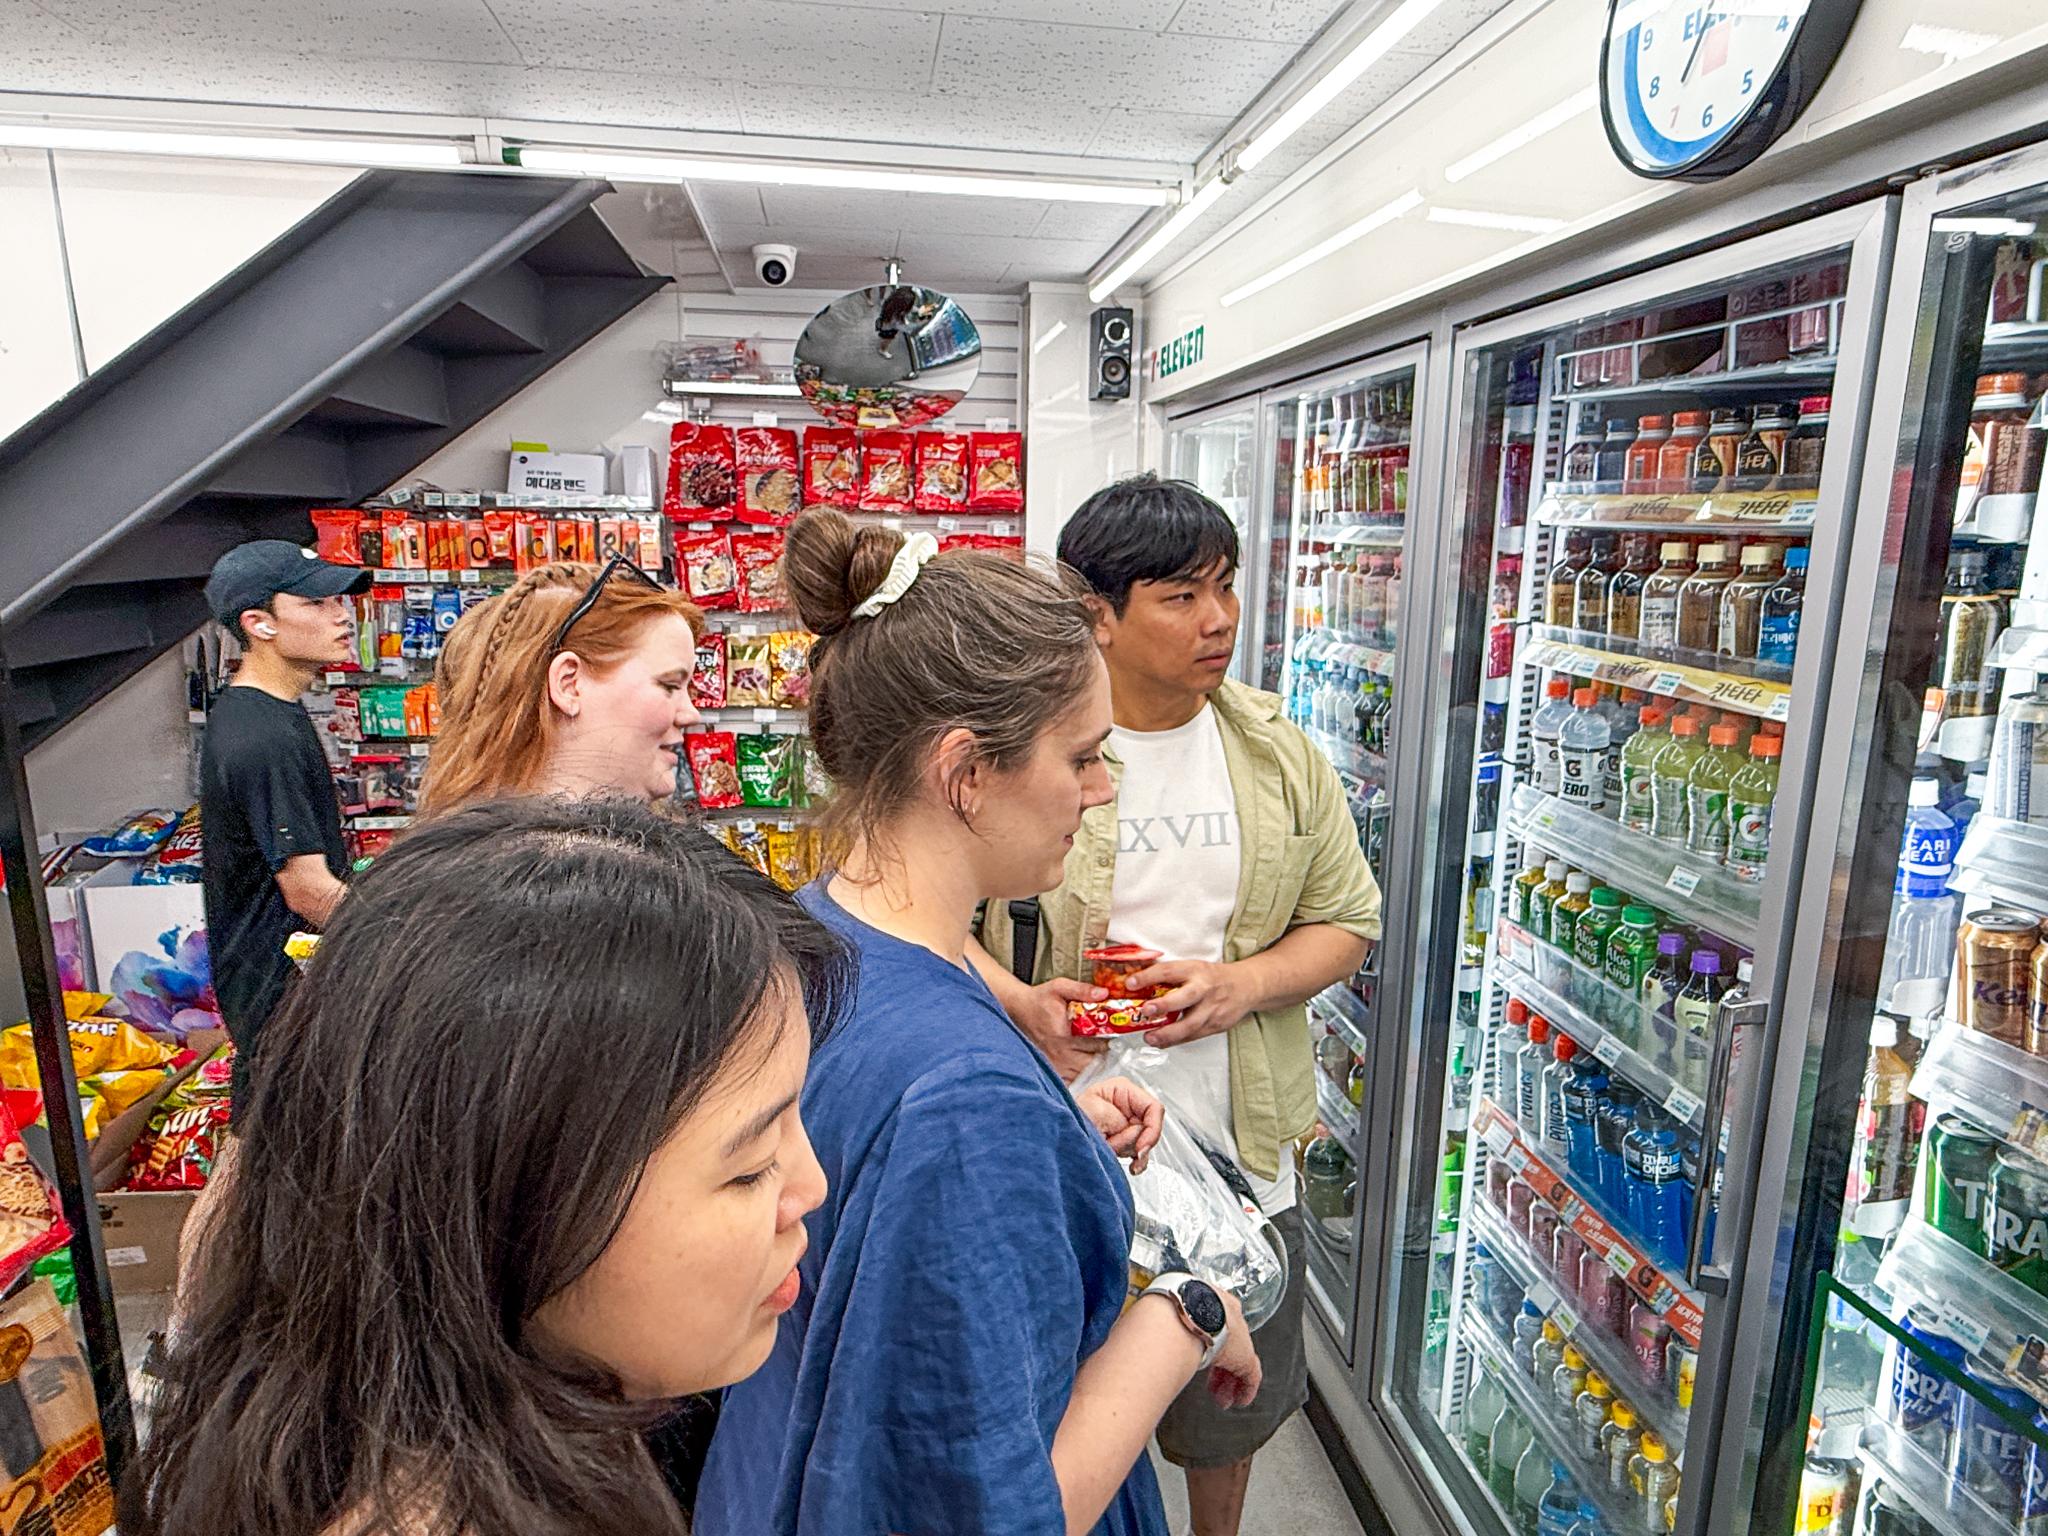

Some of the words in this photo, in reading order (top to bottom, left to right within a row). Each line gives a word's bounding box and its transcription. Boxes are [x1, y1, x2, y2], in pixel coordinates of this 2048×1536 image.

[1643, 29, 1653, 51] 9
[1649, 76, 1660, 98] 8
[1741, 69, 1753, 94] 5
[1702, 104, 1713, 128] 6
[1566, 760, 1581, 777] G
[1577, 927, 1599, 947] Aloe
[1576, 943, 1599, 965] King
[1607, 946, 1631, 967] Aloe
[1606, 962, 1631, 985] King
[1955, 1178, 1986, 1219] T
